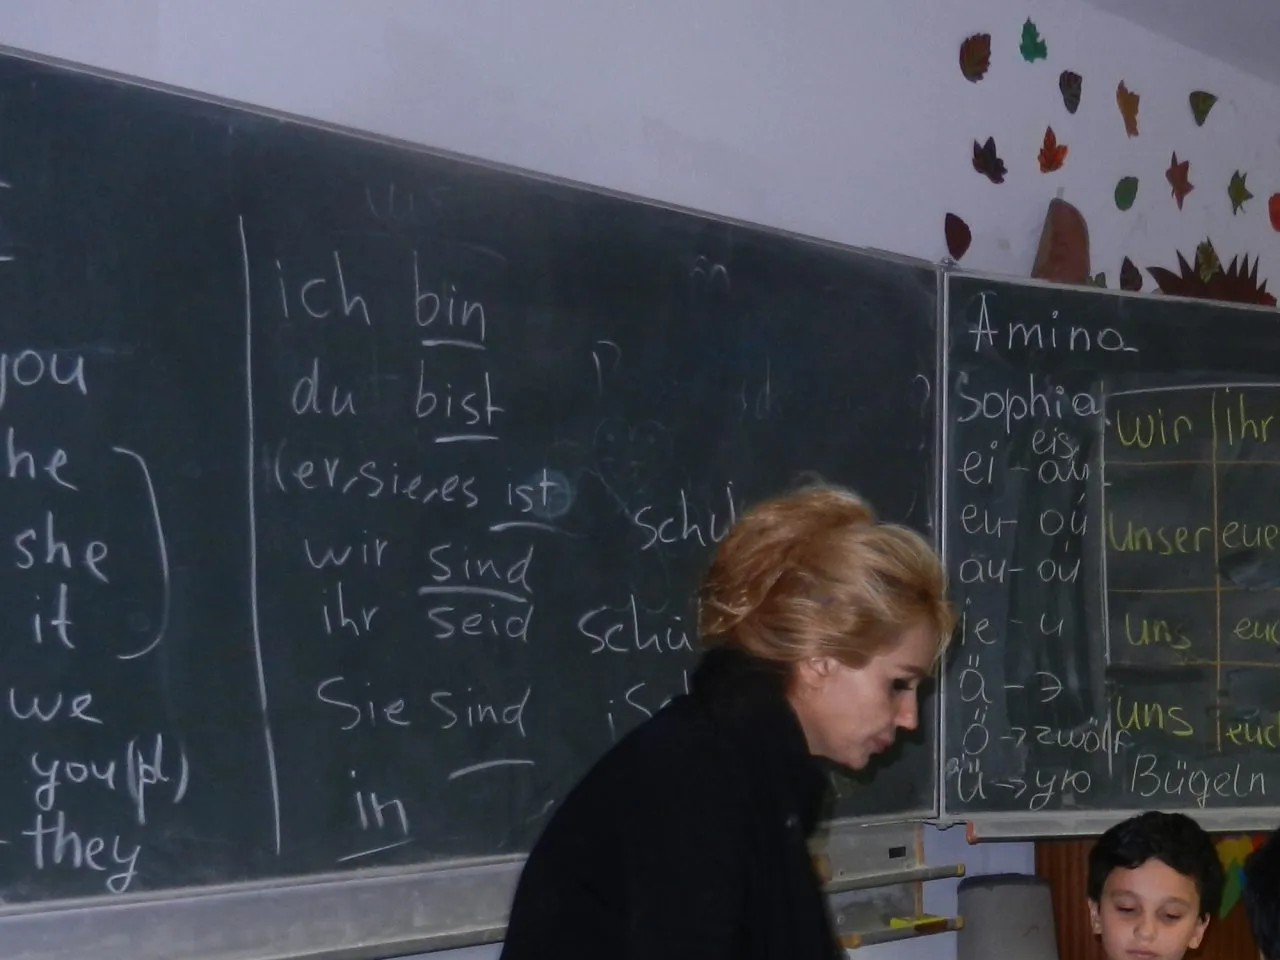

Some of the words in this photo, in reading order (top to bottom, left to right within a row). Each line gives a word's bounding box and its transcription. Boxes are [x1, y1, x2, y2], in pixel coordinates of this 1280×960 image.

[276, 250, 371, 326] ich
[413, 250, 486, 341] bin
[968, 291, 1139, 352] Amina
[291, 357, 356, 416] du
[415, 360, 504, 426] bist
[957, 372, 1105, 435] Sophia
[8, 427, 79, 491] he
[1116, 407, 1192, 449] wir
[508, 468, 557, 513] ist
[15, 511, 109, 582] she
[305, 530, 388, 569] wir
[34, 583, 75, 649] it
[10, 687, 103, 724] we
[317, 677, 412, 731] Sie
[350, 770, 408, 835] in
[1131, 753, 1266, 809] Bügeln
[21, 811, 140, 894] they
